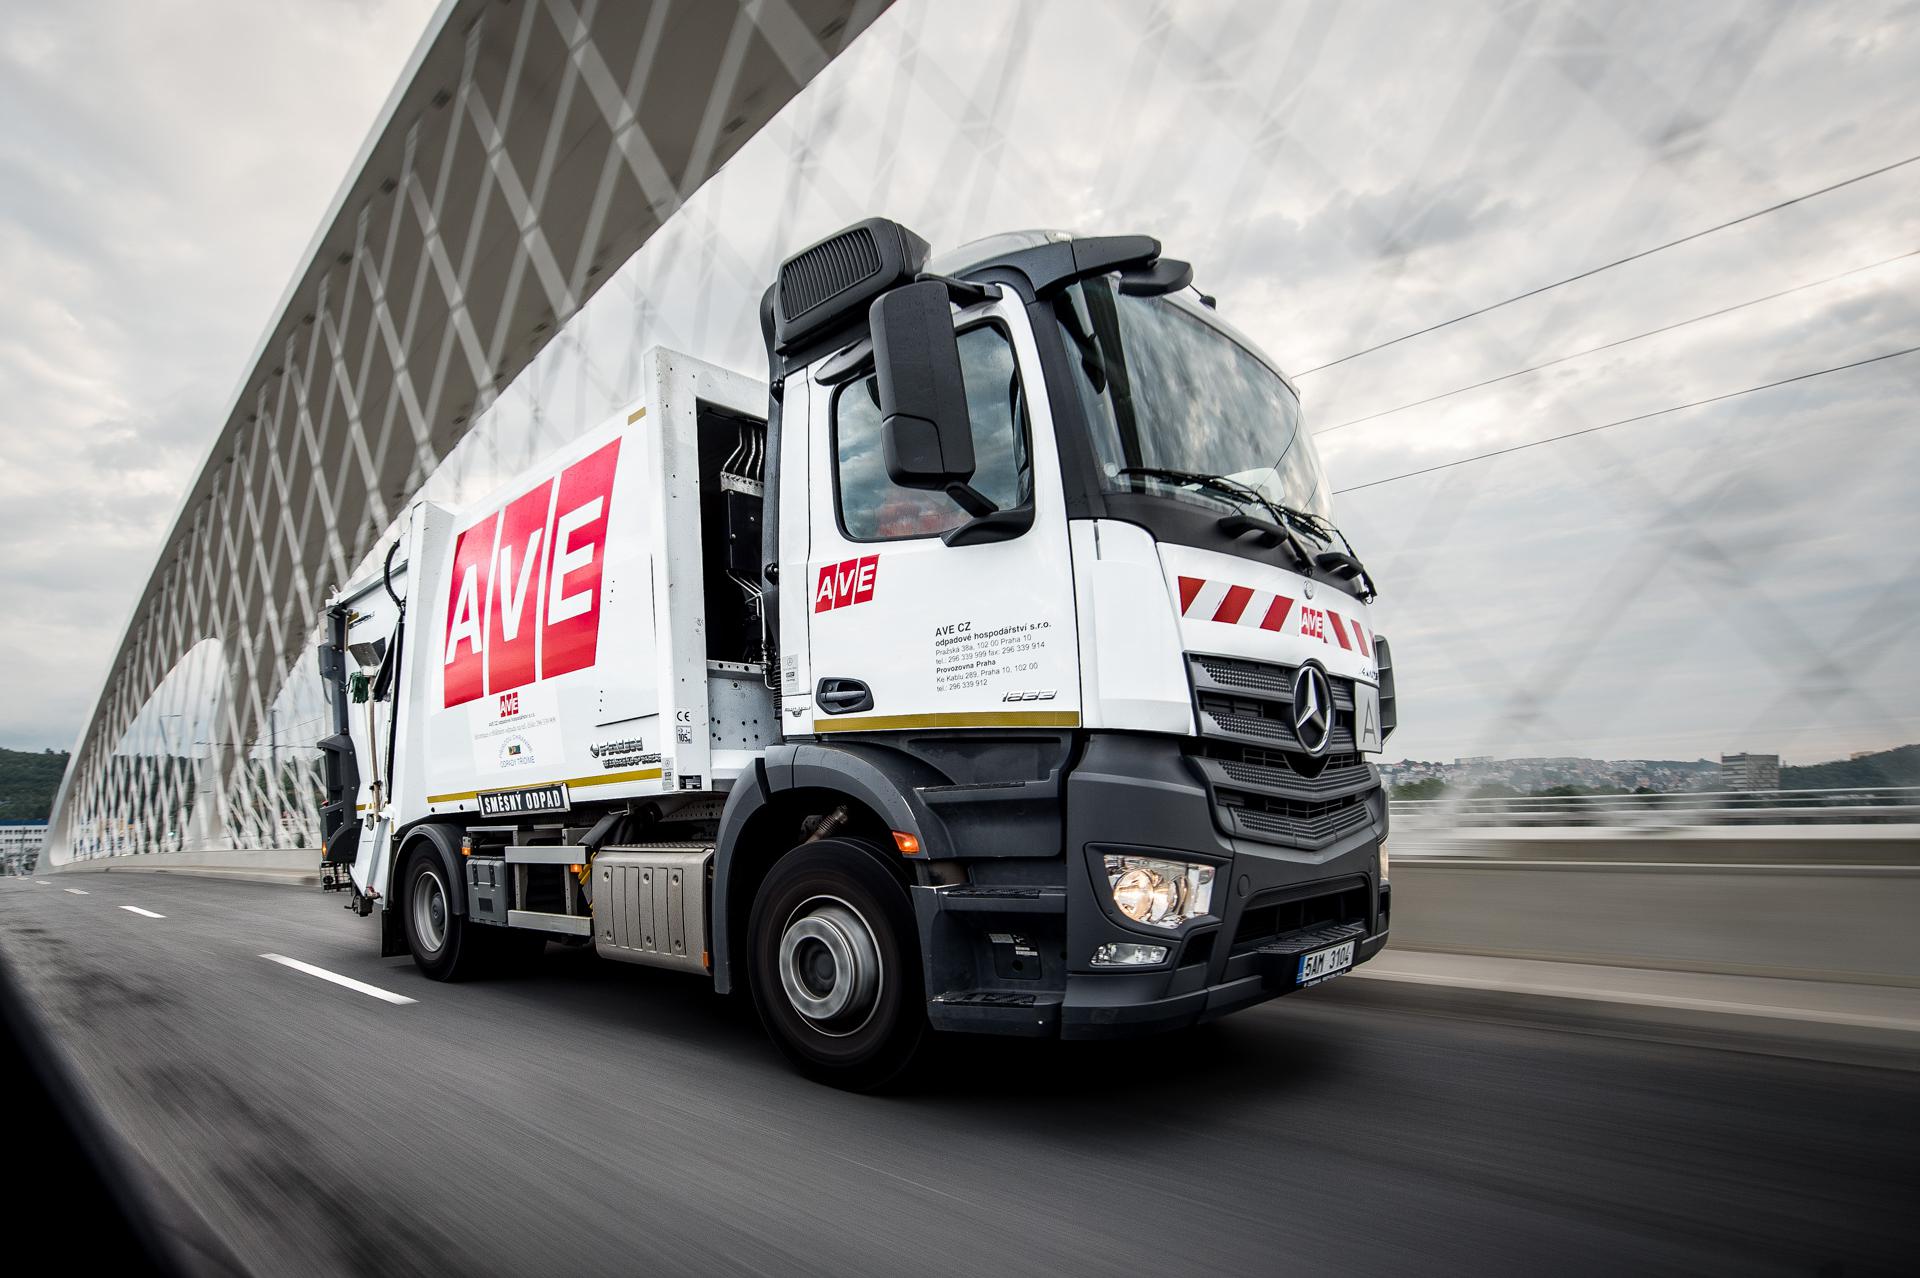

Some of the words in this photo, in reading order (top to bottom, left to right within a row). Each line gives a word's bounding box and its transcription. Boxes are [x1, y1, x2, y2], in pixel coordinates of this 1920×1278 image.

[444, 495, 604, 666] AVE
[816, 563, 876, 603] AVE
[935, 624, 955, 637] AVE
[957, 621, 971, 632] CZ
[1301, 611, 1323, 633] AVE
[935, 634, 972, 647] odpadové
[1030, 621, 1052, 631] s.r.o.
[977, 641, 989, 649] 102
[1000, 635, 1021, 645] Praha
[948, 654, 960, 663] 296
[961, 652, 973, 661] 339
[974, 650, 986, 659] 999
[1002, 645, 1014, 655] 296
[1017, 643, 1030, 652] 339
[1032, 641, 1045, 650] 914
[936, 661, 974, 674] Provozovna
[976, 659, 996, 668] Praha
[981, 667, 1000, 677] Praha
[1015, 663, 1027, 671] 102
[1028, 662, 1038, 670] 00
[949, 681, 960, 691] 296
[962, 680, 974, 689] 339
[975, 678, 988, 687] 912
[1002, 690, 1057, 702] 1833
[676, 711, 691, 722] CE
[1363, 699, 1377, 744] A
[484, 791, 522, 813] SMĚSNÝ
[526, 790, 561, 810] ODPAD
[1305, 953, 1325, 977] 5AM
[1329, 945, 1351, 970] 3104
